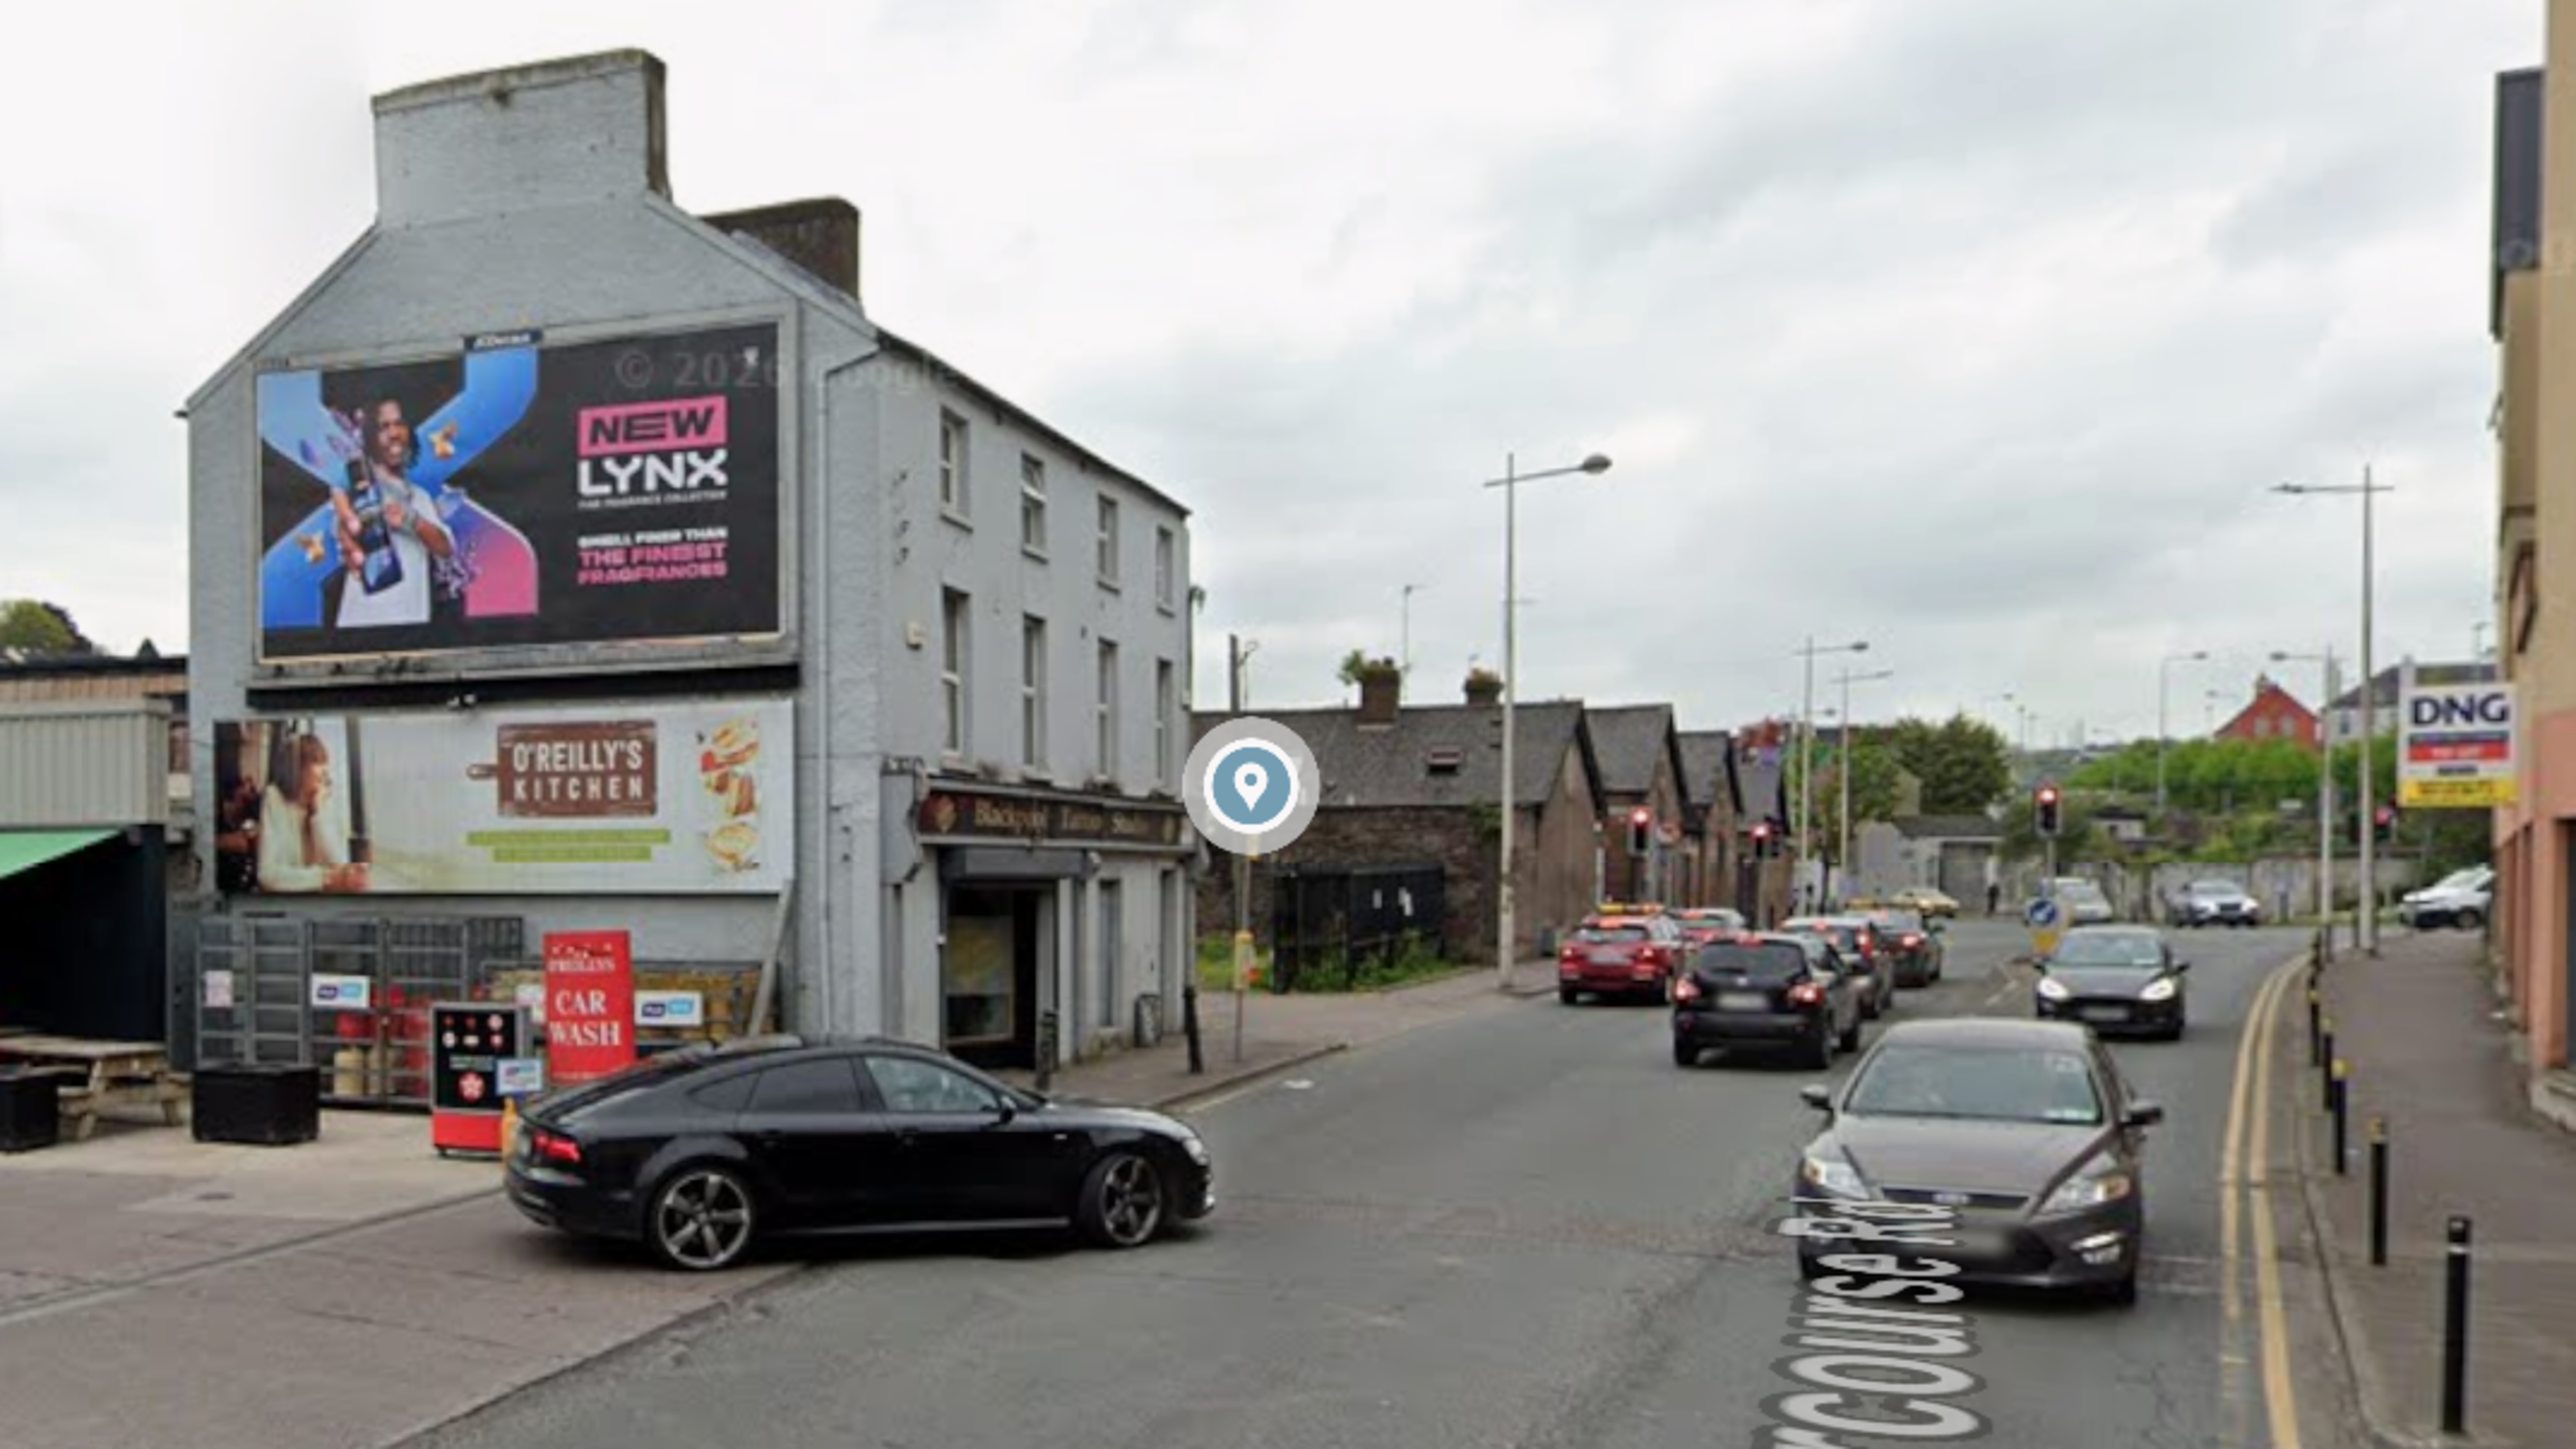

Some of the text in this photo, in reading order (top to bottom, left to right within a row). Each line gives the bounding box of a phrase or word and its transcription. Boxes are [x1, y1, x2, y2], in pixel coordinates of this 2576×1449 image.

[589, 407, 715, 446] NEW
[580, 448, 728, 496] LYNX
[684, 527, 728, 541] THAN
[579, 541, 727, 567] THE FINEST
[578, 561, 727, 585] FRAGRANCES
[2410, 692, 2510, 726] DNG
[513, 739, 643, 772] O'REILLY'S
[513, 775, 643, 801] KITCHEN
[555, 989, 607, 1016] CAR
[549, 1020, 621, 1046] WASH
